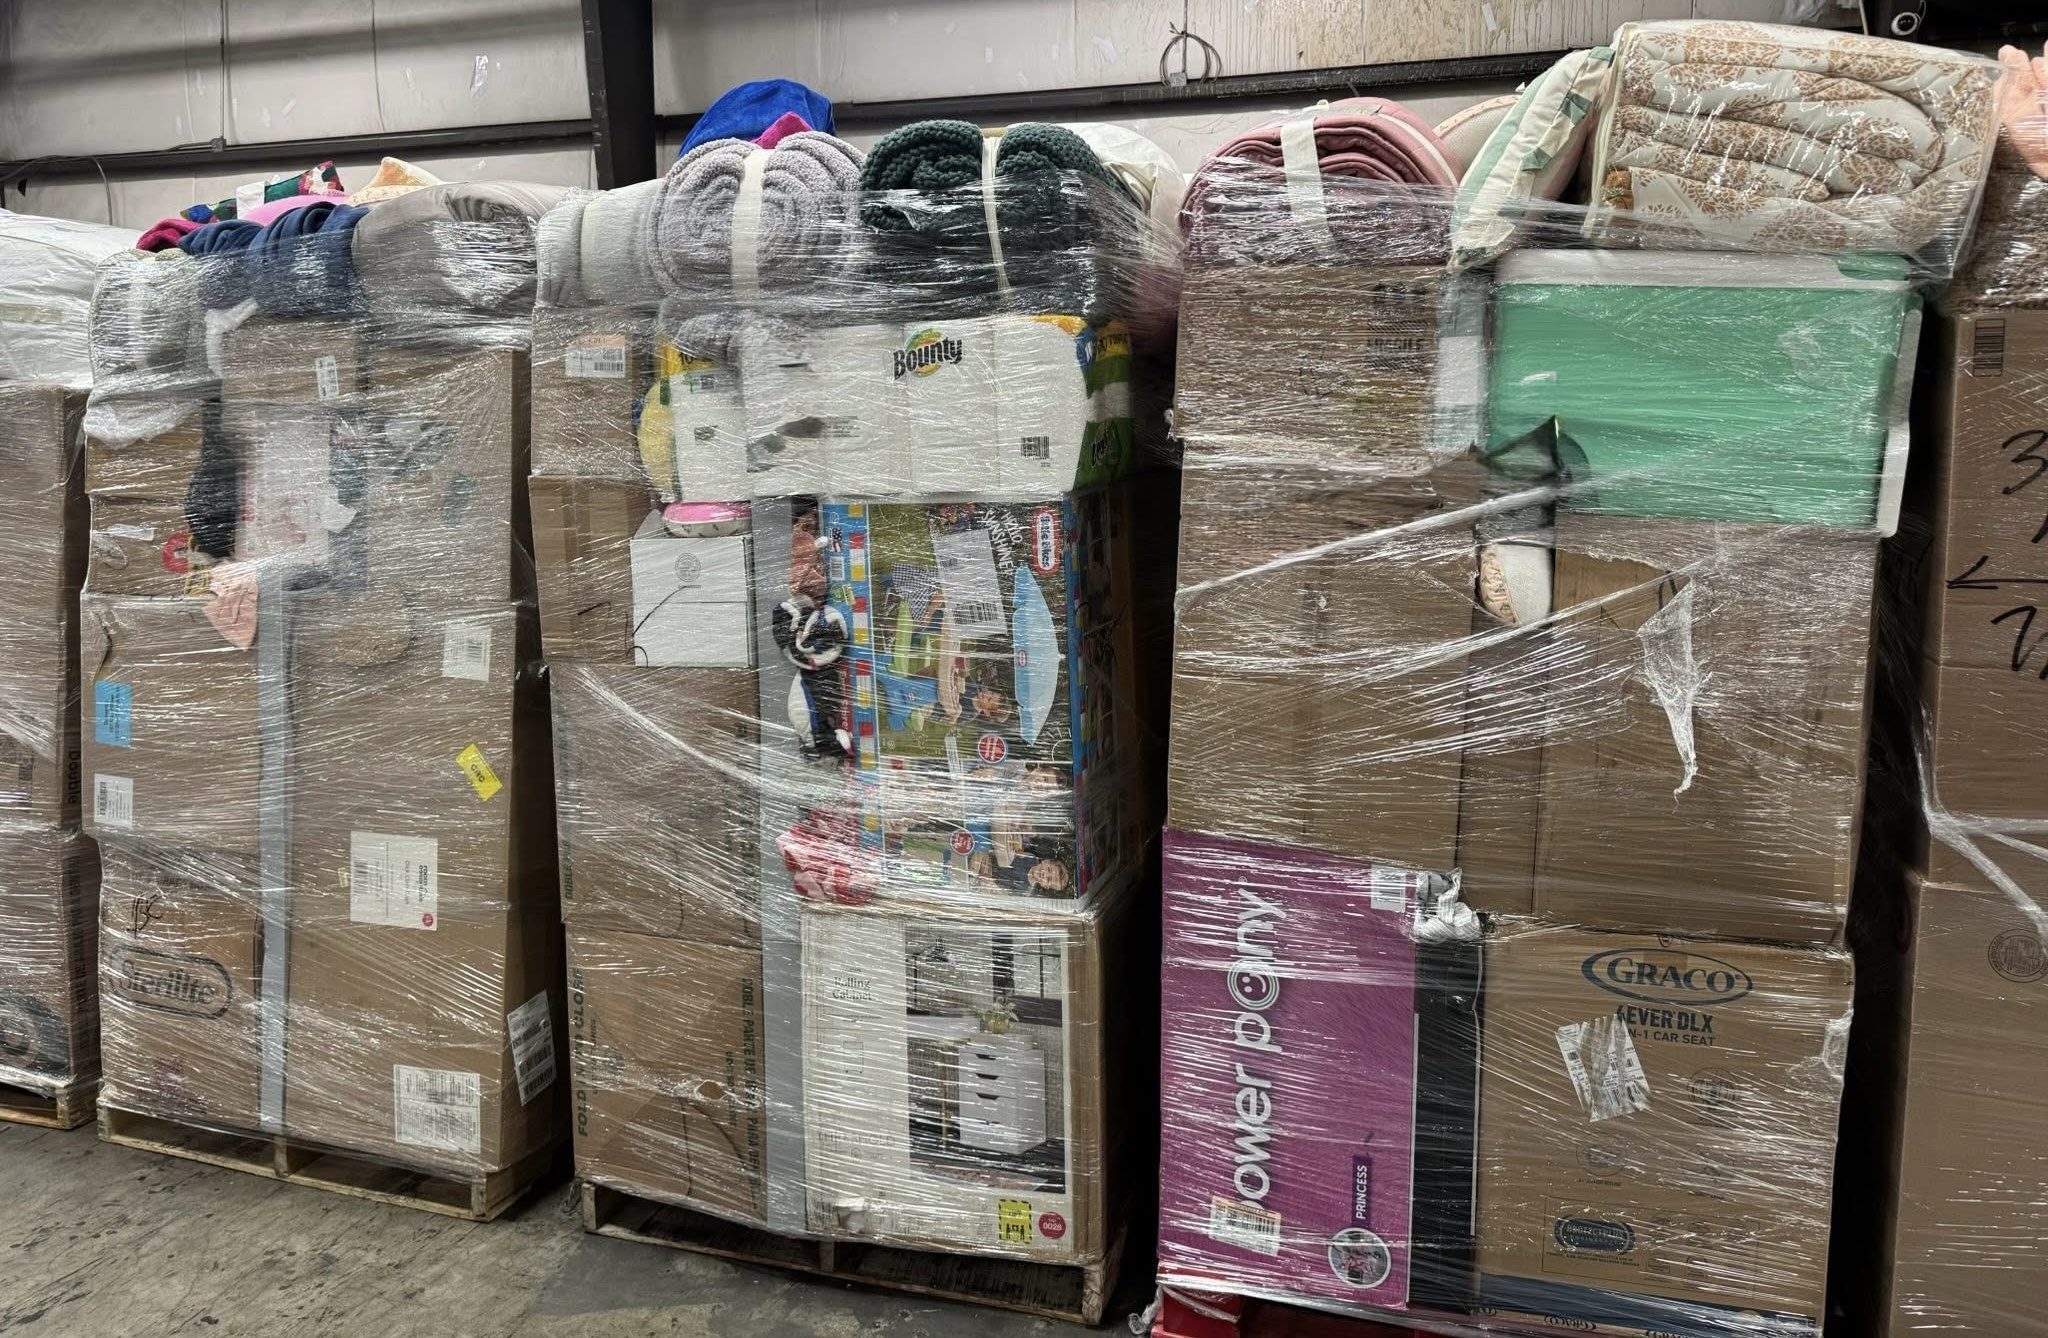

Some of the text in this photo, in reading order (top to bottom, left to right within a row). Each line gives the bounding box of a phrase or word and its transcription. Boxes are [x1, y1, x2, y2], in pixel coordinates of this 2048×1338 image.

[893, 336, 963, 381] Bounty
[1607, 957, 1736, 993] GRACO
[1653, 1031, 1678, 1043] CAR
[1682, 1034, 1714, 1046] SEAT
[1677, 1011, 1714, 1033] DLX
[576, 1090, 588, 1137] FOLD
[1355, 1164, 1368, 1220] PRINCESS
[1042, 1222, 1063, 1231] 0028
